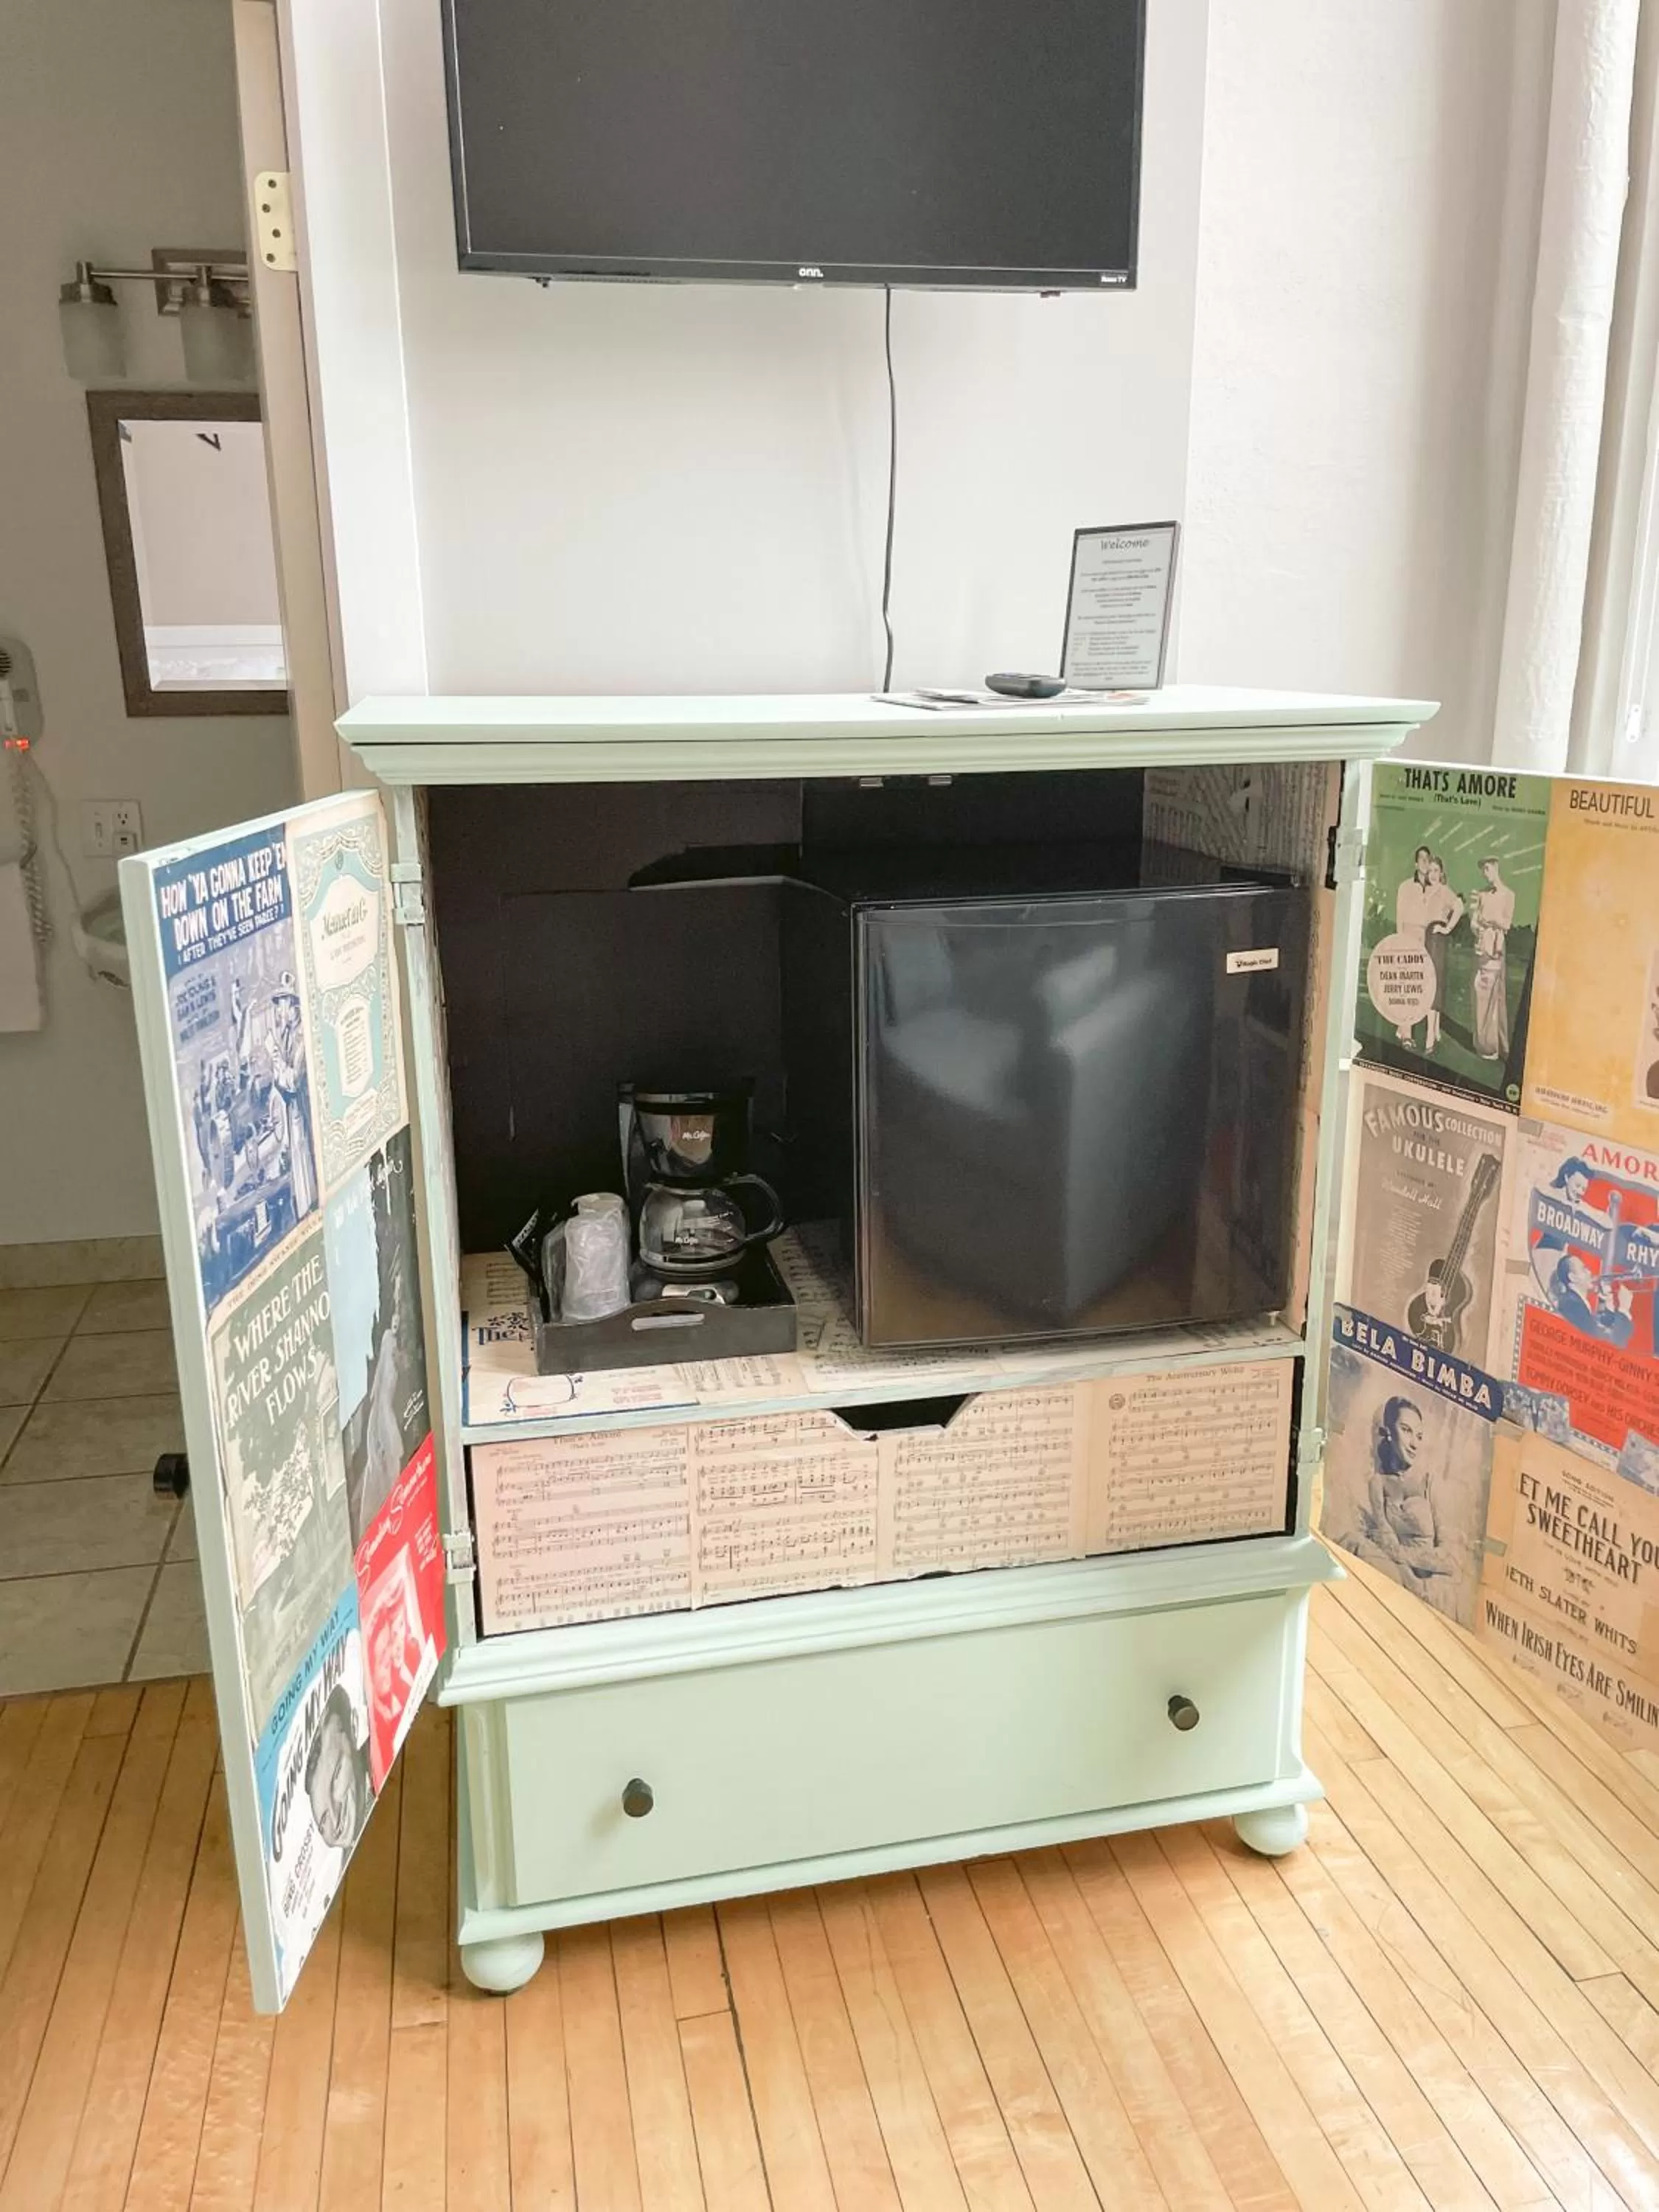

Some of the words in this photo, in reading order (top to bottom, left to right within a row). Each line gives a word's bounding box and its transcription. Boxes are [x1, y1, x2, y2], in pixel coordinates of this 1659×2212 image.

[1100, 538, 1150, 551] Welcome
[1457, 772, 1517, 799] AMORE
[1570, 789, 1655, 818] BEAUTIFUL
[160, 880, 187, 919] HOW
[209, 858, 247, 898] GONNA
[247, 847, 272, 883] KEEP
[173, 906, 209, 951] DOWN
[212, 896, 229, 931] ON
[231, 886, 254, 922] THE
[254, 874, 283, 912] FARM
[1364, 1105, 1444, 1138] FAMOUS
[1445, 1117, 1502, 1148] COLLECTION
[1392, 1135, 1465, 1177] UKULELE
[1582, 1144, 1658, 1181] AMOR
[1537, 1200, 1605, 1250] BROADWAY
[233, 1285, 292, 1363] WHERE
[291, 1254, 324, 1304] THE
[226, 1357, 272, 1428] RIVER
[274, 1291, 331, 1374] SHANNO
[265, 1345, 319, 1427] FLOWS
[1341, 1319, 1398, 1360] BELA
[1411, 1349, 1492, 1411] BIMBA
[1526, 1503, 1642, 1585] SWEETHEART
[1545, 1486, 1571, 1520] ME
[1577, 1505, 1622, 1548] CALL
[1538, 1585, 1587, 1625] SLATER
[271, 1671, 303, 1735] GOING
[304, 1642, 318, 1678] MY
[319, 1604, 340, 1647] WAY
[1486, 1599, 1518, 1640] WHEN
[1521, 1621, 1553, 1663] IRISH
[1555, 1641, 1585, 1682] EYES
[1585, 1661, 1613, 1700] ARE
